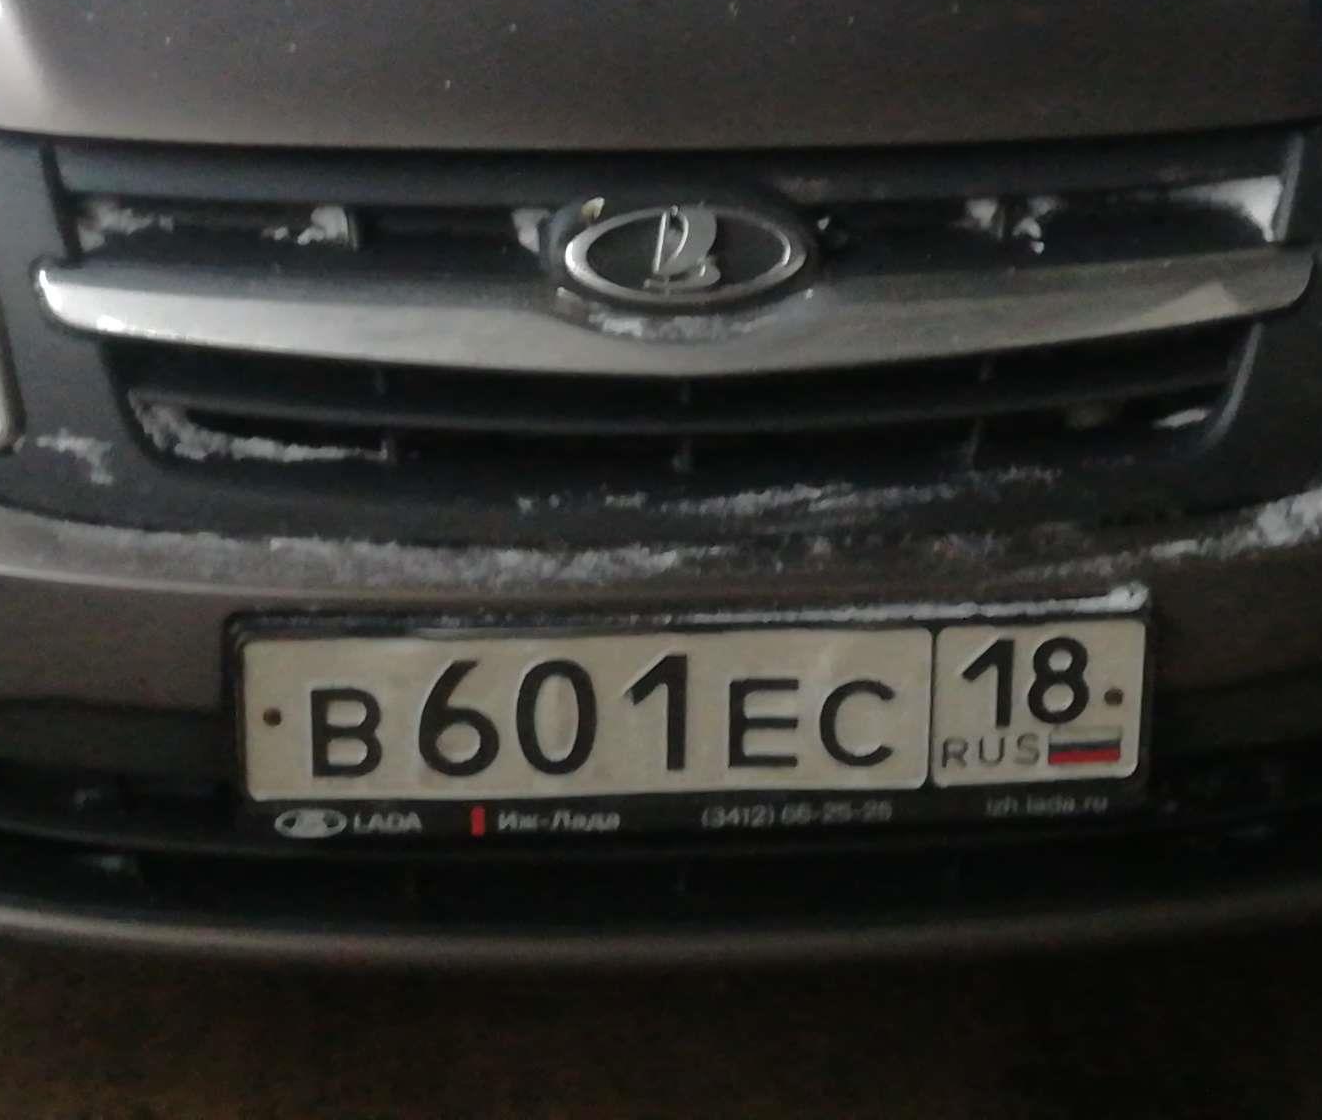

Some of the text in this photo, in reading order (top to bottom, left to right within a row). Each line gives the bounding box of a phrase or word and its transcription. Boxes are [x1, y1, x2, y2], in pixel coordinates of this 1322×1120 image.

[961, 635, 1090, 729] 18
[309, 653, 896, 779] В601ЕС
[941, 732, 1041, 769] RUS
[353, 810, 424, 831] LADA
